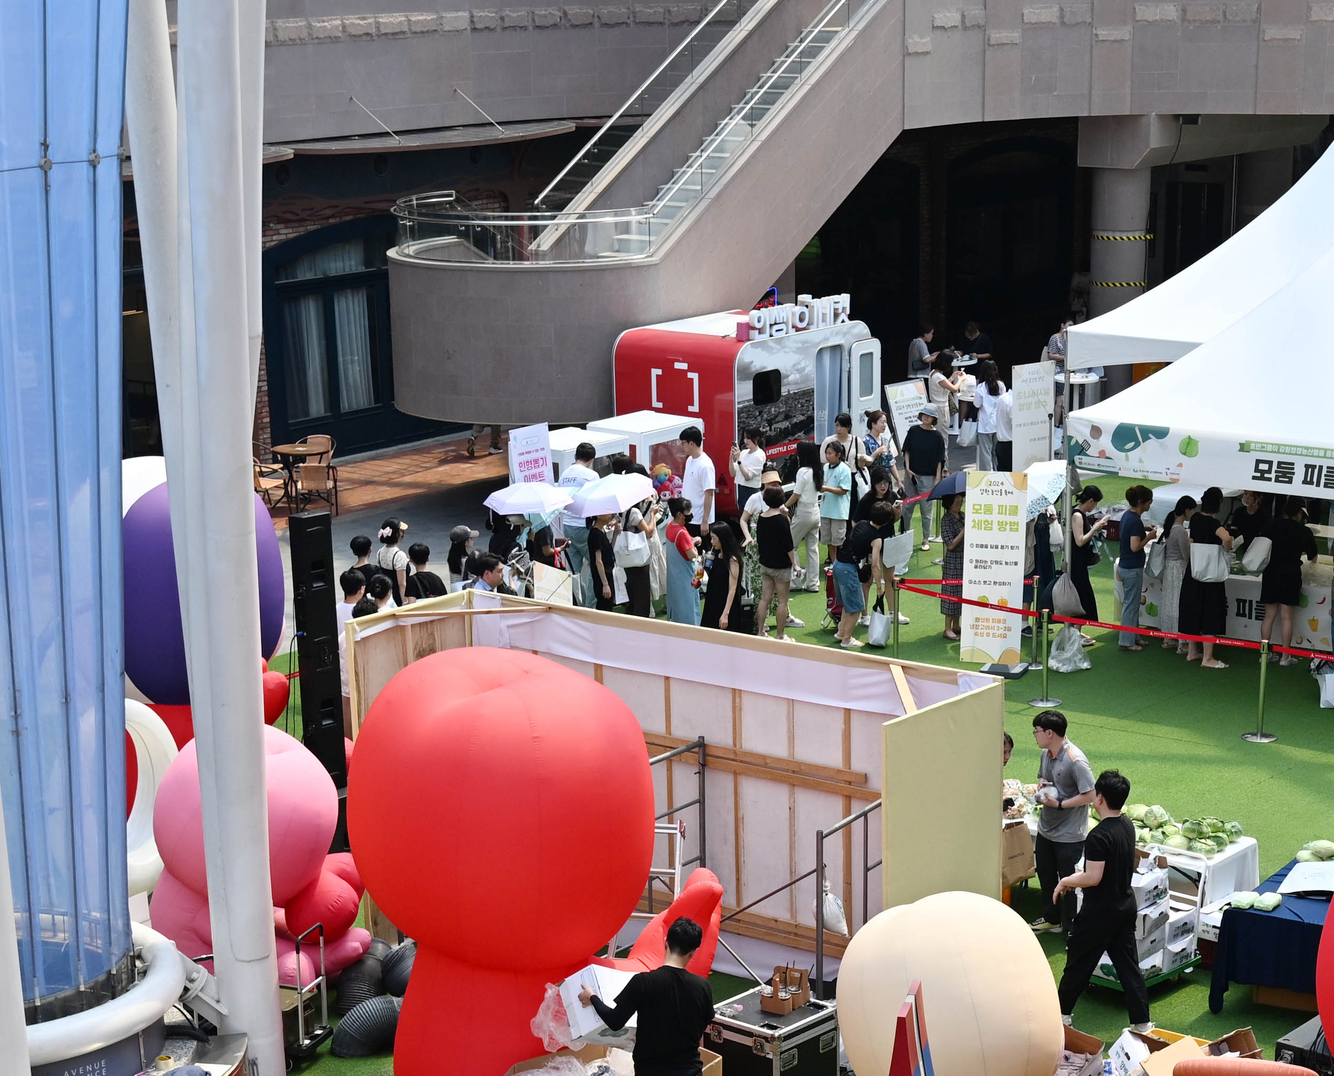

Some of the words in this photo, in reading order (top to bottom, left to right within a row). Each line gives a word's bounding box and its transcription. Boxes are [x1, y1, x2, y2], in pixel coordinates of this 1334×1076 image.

[766, 445, 787, 456] LIFESTYLE
[518, 456, 548, 473] 인형뽑기
[1251, 458, 1296, 485] 모둠
[561, 477, 578, 485] STAFF
[971, 503, 994, 515] 모둠
[997, 504, 1019, 517] 피클
[971, 519, 994, 531] 체험
[997, 520, 1020, 533] 방법
